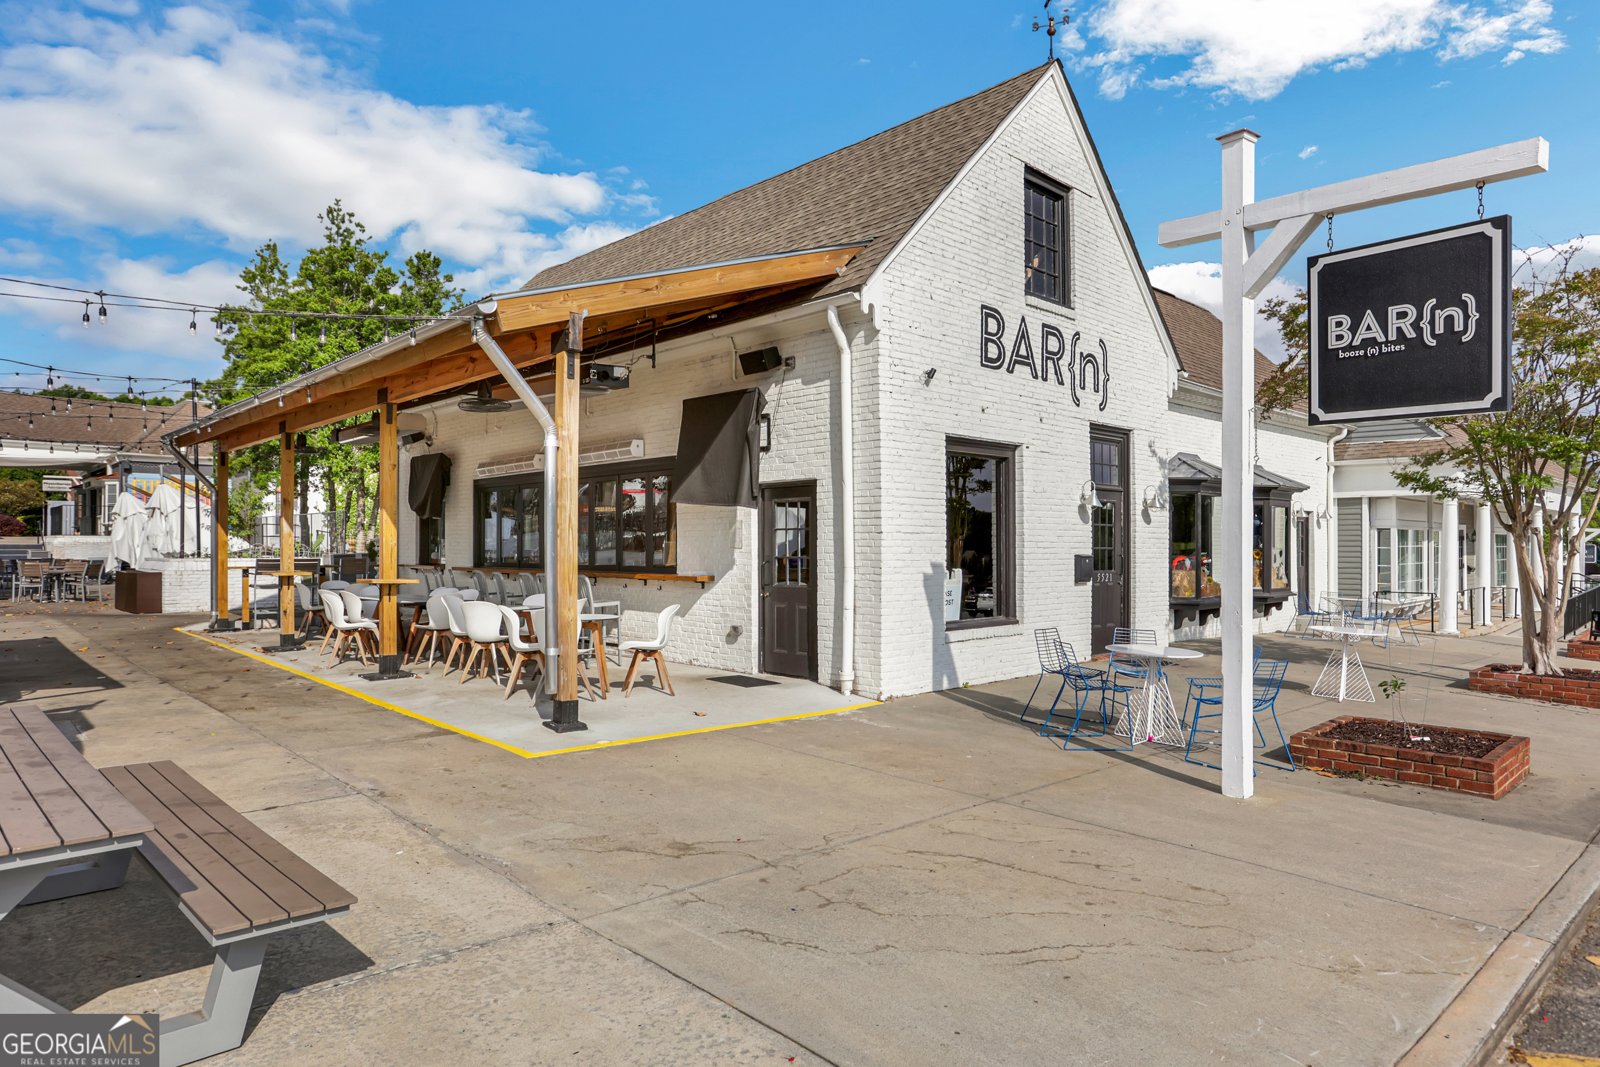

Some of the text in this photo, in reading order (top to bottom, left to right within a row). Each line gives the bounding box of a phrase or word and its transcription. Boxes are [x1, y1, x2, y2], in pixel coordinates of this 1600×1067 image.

[1327, 293, 1480, 349] BAR{n}
[980, 304, 1110, 411] BAR{n}
[1338, 343, 1406, 358] booze {n} bites
[1096, 572, 1113, 582] 5521
